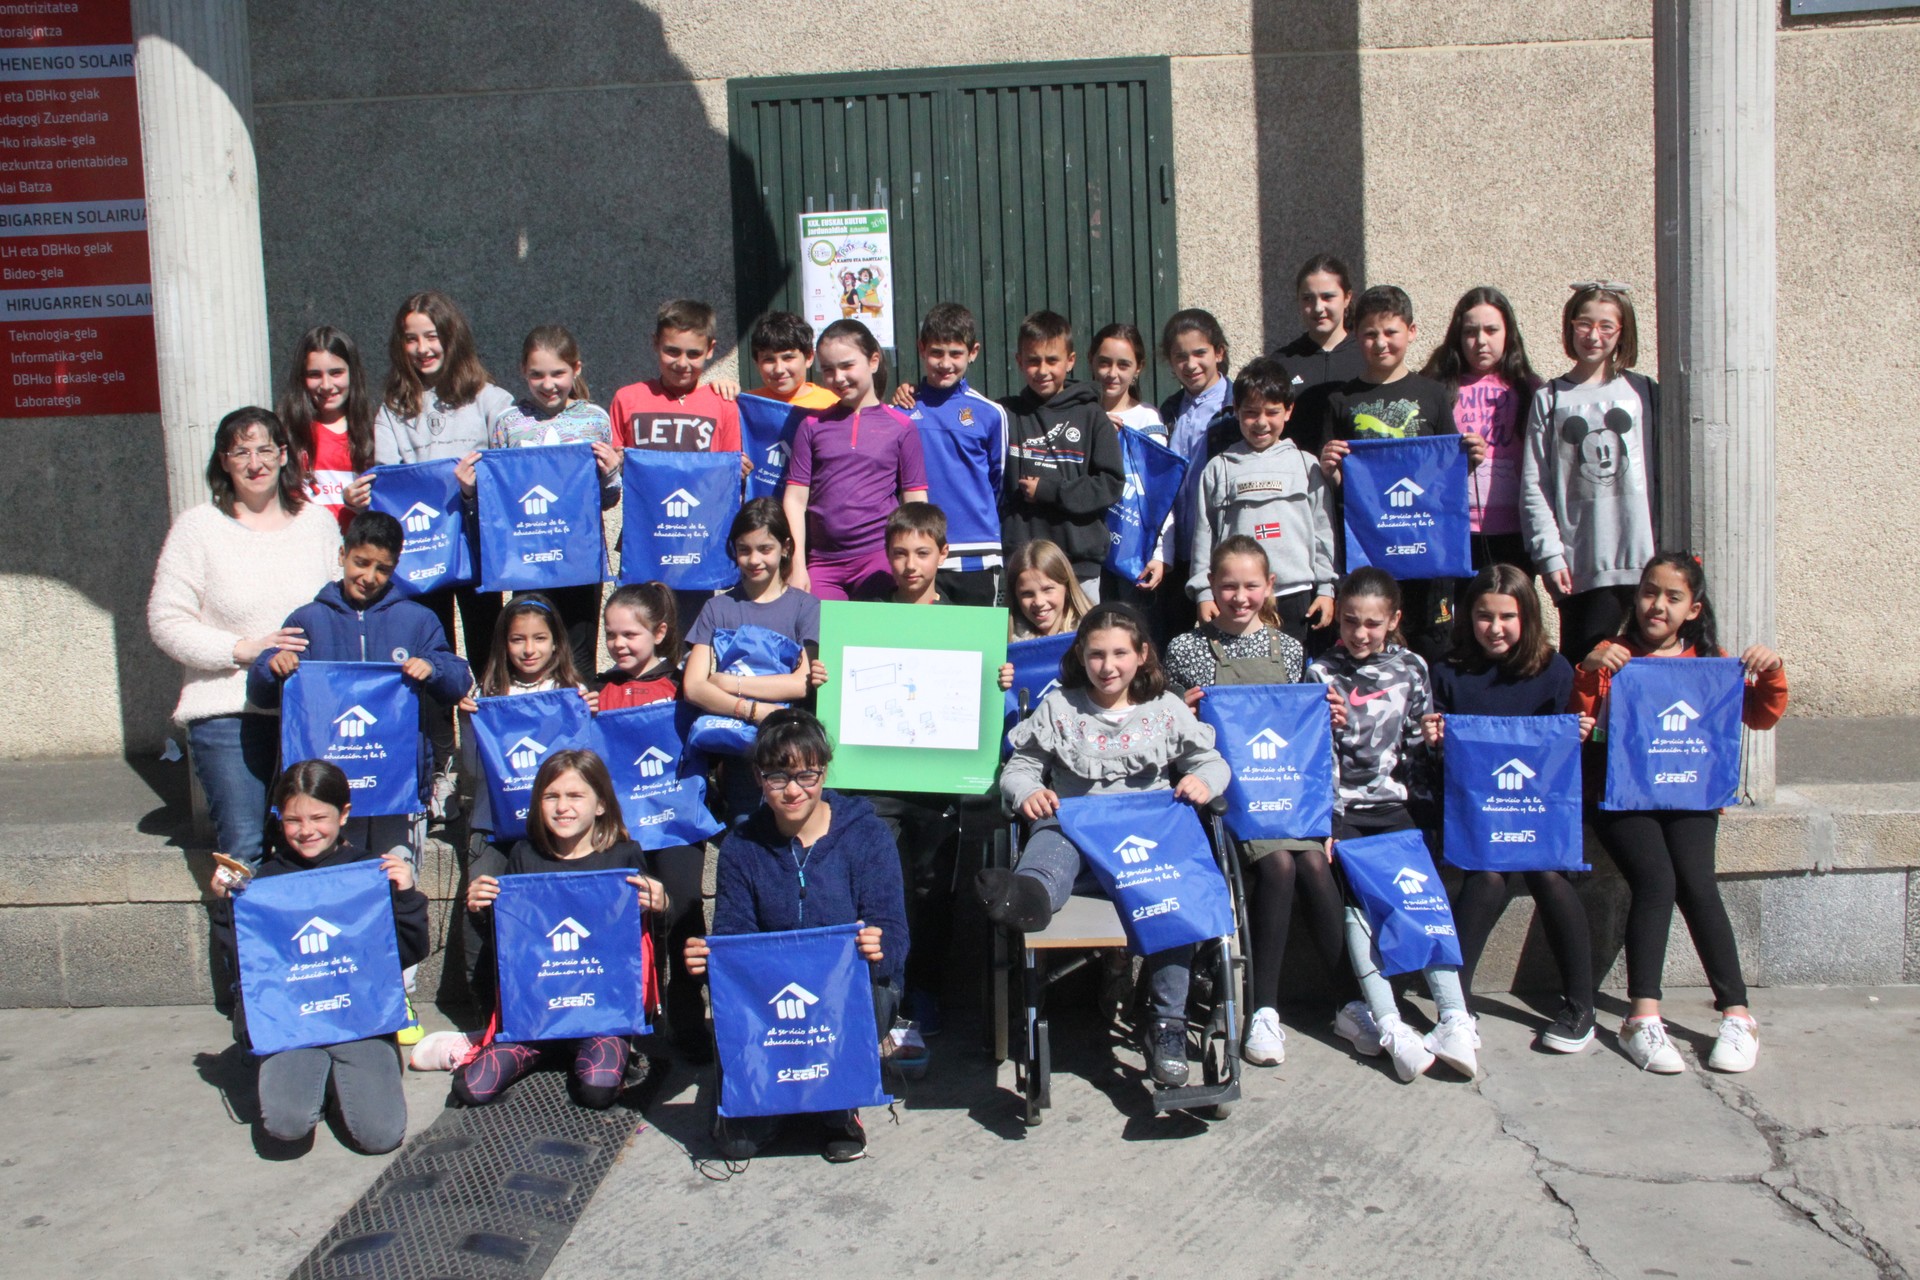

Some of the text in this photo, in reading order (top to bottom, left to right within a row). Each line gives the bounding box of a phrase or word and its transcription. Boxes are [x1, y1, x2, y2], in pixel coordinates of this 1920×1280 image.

[0, 54, 134, 71] HENENGO SOLAIR
[5, 88, 100, 102] eta DBHko gelak
[43, 111, 108, 124] Zuzendaria
[22, 134, 96, 148] irakasle-gela
[0, 155, 128, 171] ezkuntza orientabidea
[20, 181, 52, 192] Batza
[0, 212, 73, 227] BIGARREN
[2, 242, 113, 258] LH eta DBHko gelak
[4, 267, 64, 280] Bideo-gela
[7, 293, 152, 312] HIRUGARREN SOLAI
[9, 328, 98, 342] Teknologia-gela
[11, 350, 103, 364] Informatika-gela
[14, 371, 126, 386] DBHko irakasle-gela
[16, 396, 81, 408] Laborategia
[1460, 386, 1508, 409] WILD
[1462, 413, 1476, 423] as
[634, 418, 714, 450] LET'S
[1428, 519, 1435, 527] fe
[380, 750, 387, 758] fe
[1701, 746, 1708, 754] fe
[1294, 773, 1300, 781] fe
[1539, 805, 1546, 813] fe
[1173, 870, 1180, 879] fe
[331, 957, 340, 965] de
[350, 964, 358, 973] fe
[597, 966, 604, 974] fe
[808, 1026, 818, 1034] de
[828, 1033, 836, 1042] fe
